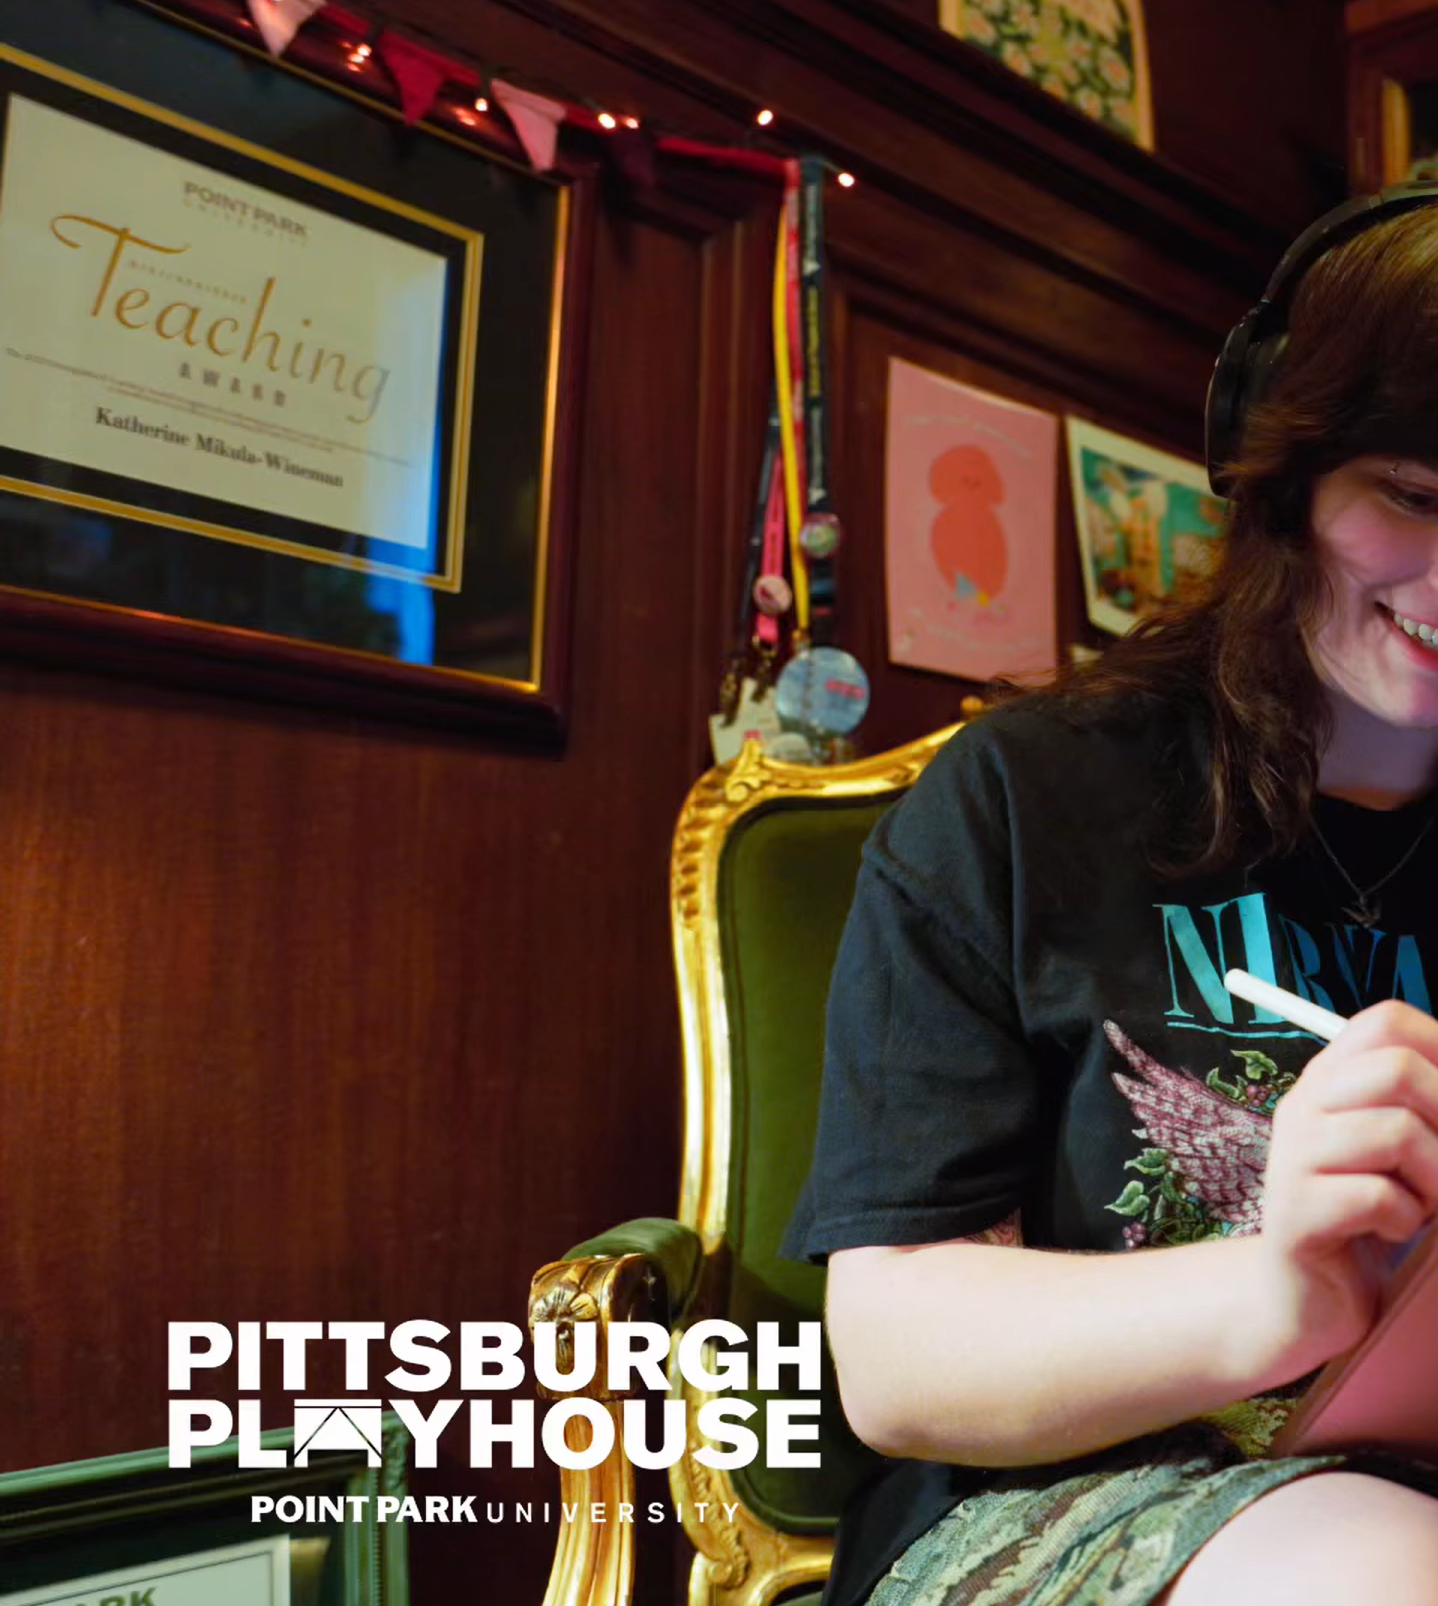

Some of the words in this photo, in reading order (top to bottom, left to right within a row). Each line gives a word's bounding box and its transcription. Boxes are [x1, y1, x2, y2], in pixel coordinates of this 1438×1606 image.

[183, 180, 249, 217] POINT
[252, 206, 308, 237] PARK
[50, 214, 391, 425] Teaching
[96, 407, 190, 446] Katherine
[195, 433, 344, 487] Mikula-Wineman
